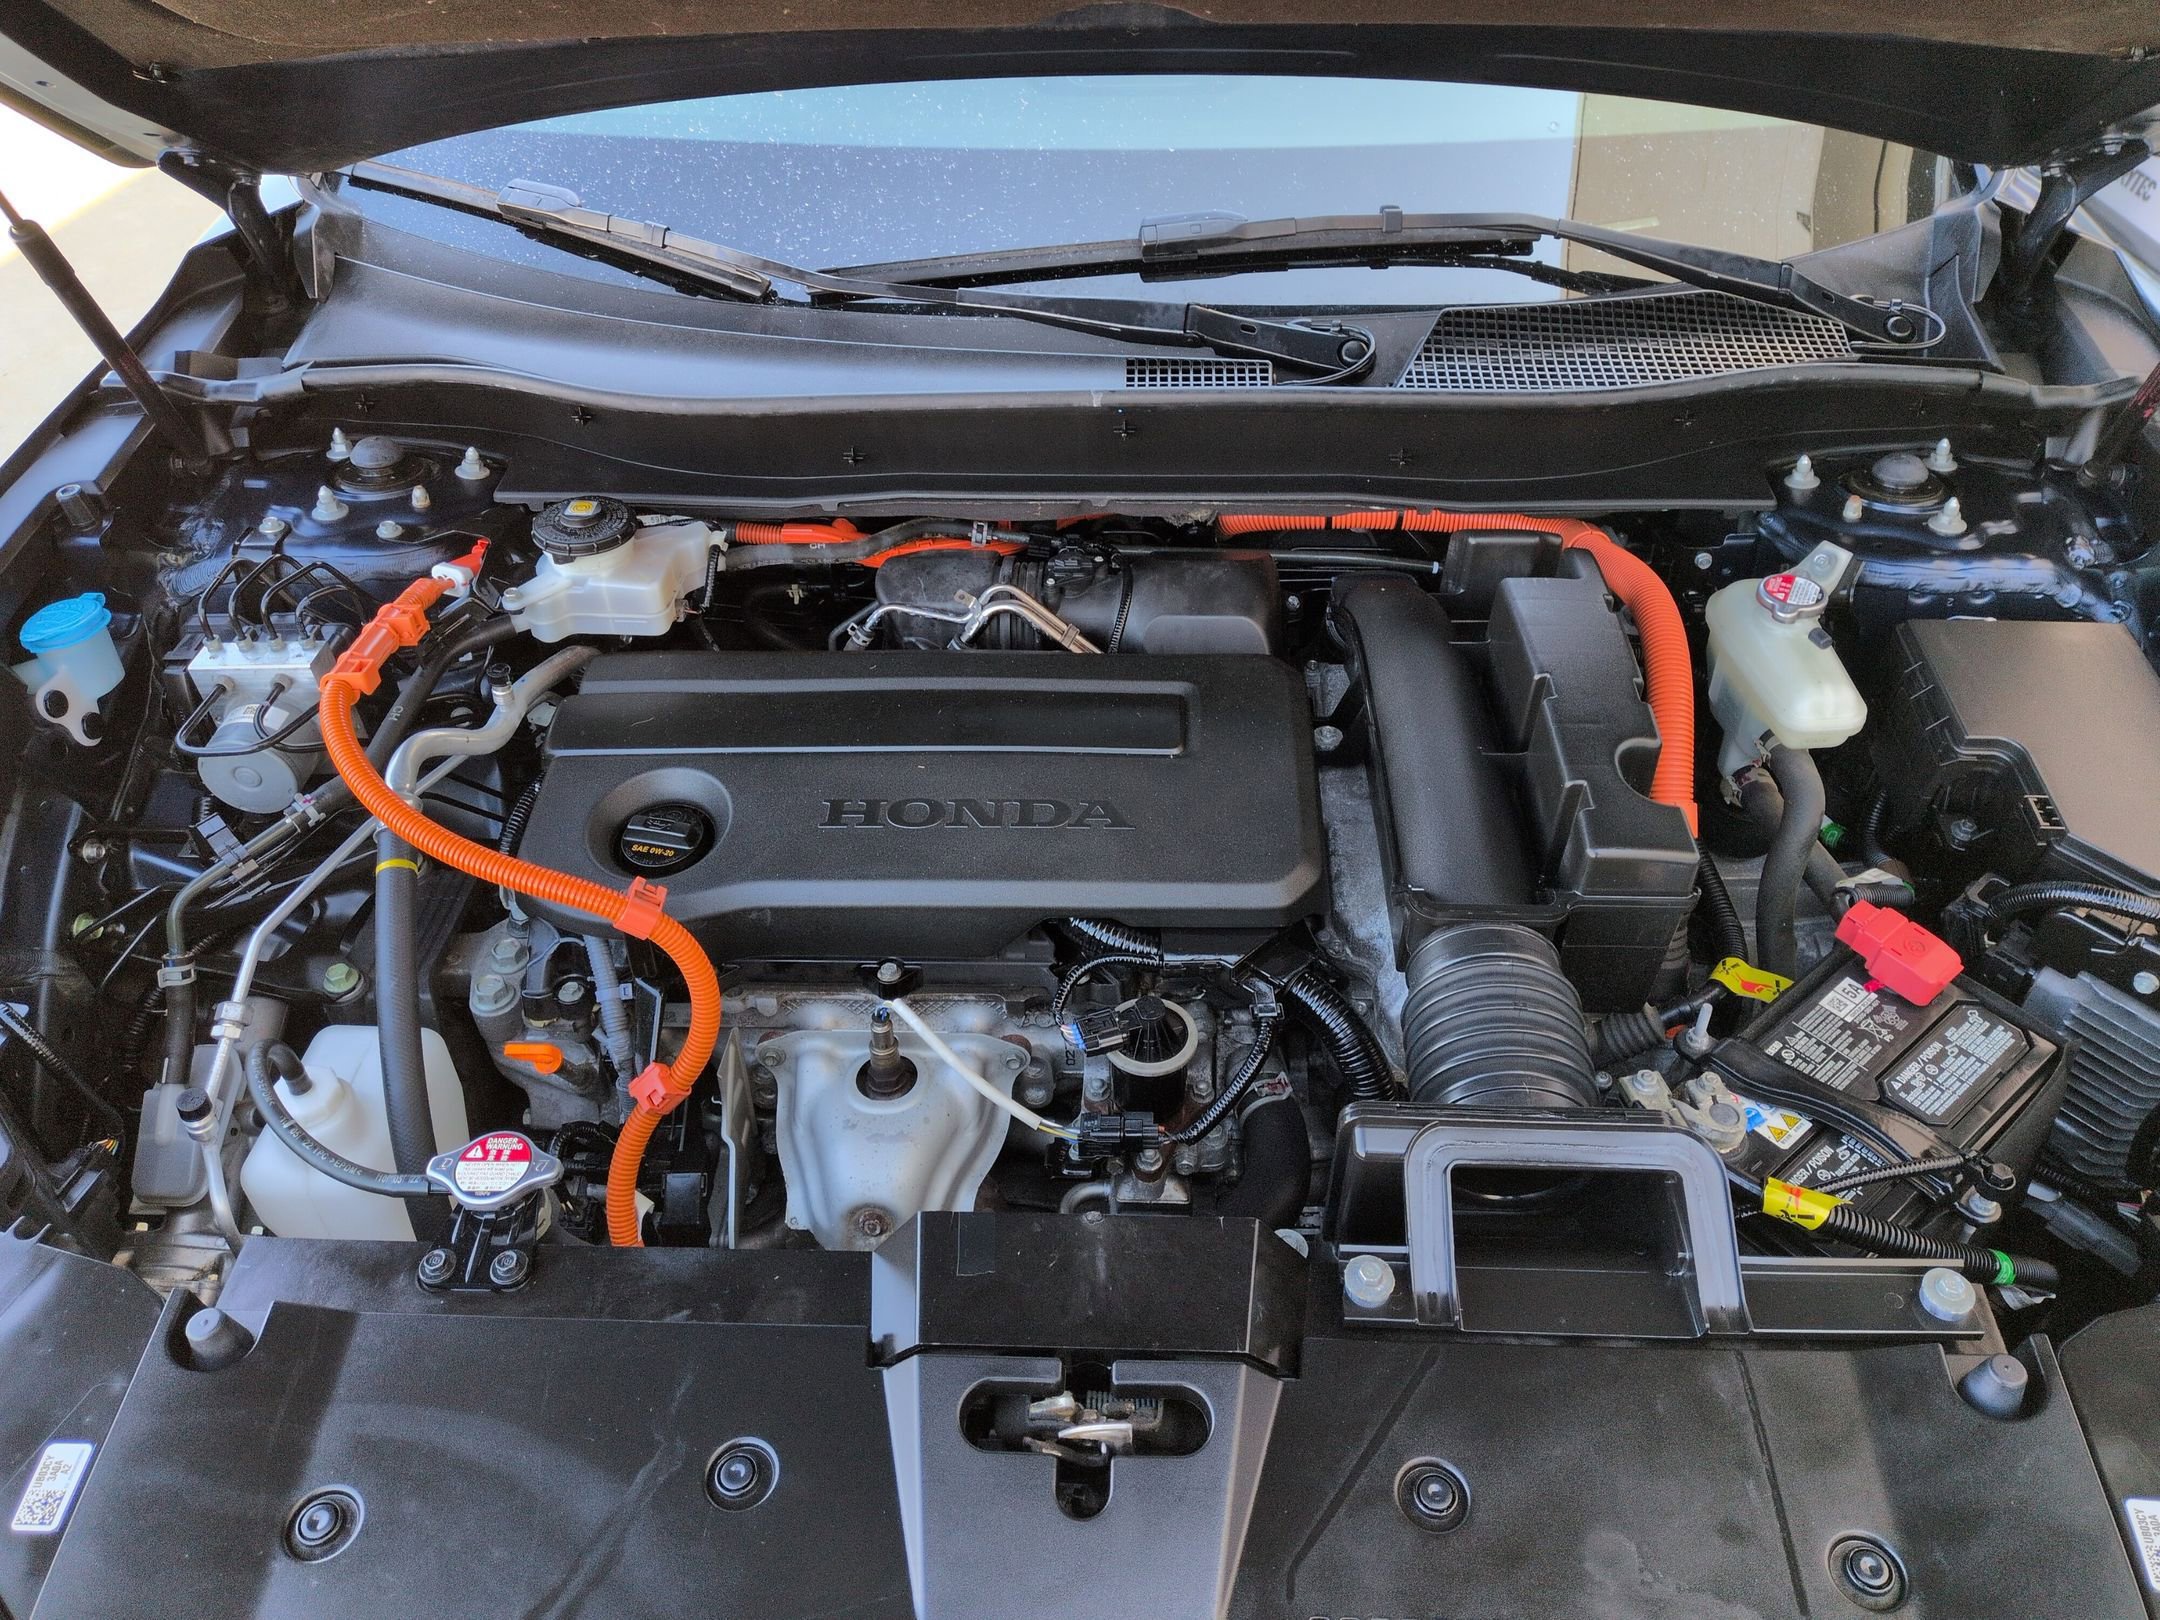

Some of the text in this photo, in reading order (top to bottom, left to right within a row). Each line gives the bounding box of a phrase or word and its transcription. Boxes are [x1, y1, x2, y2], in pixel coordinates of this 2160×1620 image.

[818, 798, 1137, 829] HONDA
[632, 844, 675, 857] SAE 0W-20
[1842, 983, 1865, 999] 5A
[33, 1455, 54, 1488] UB03CY
[2133, 1508, 2154, 1543] UB03CY
